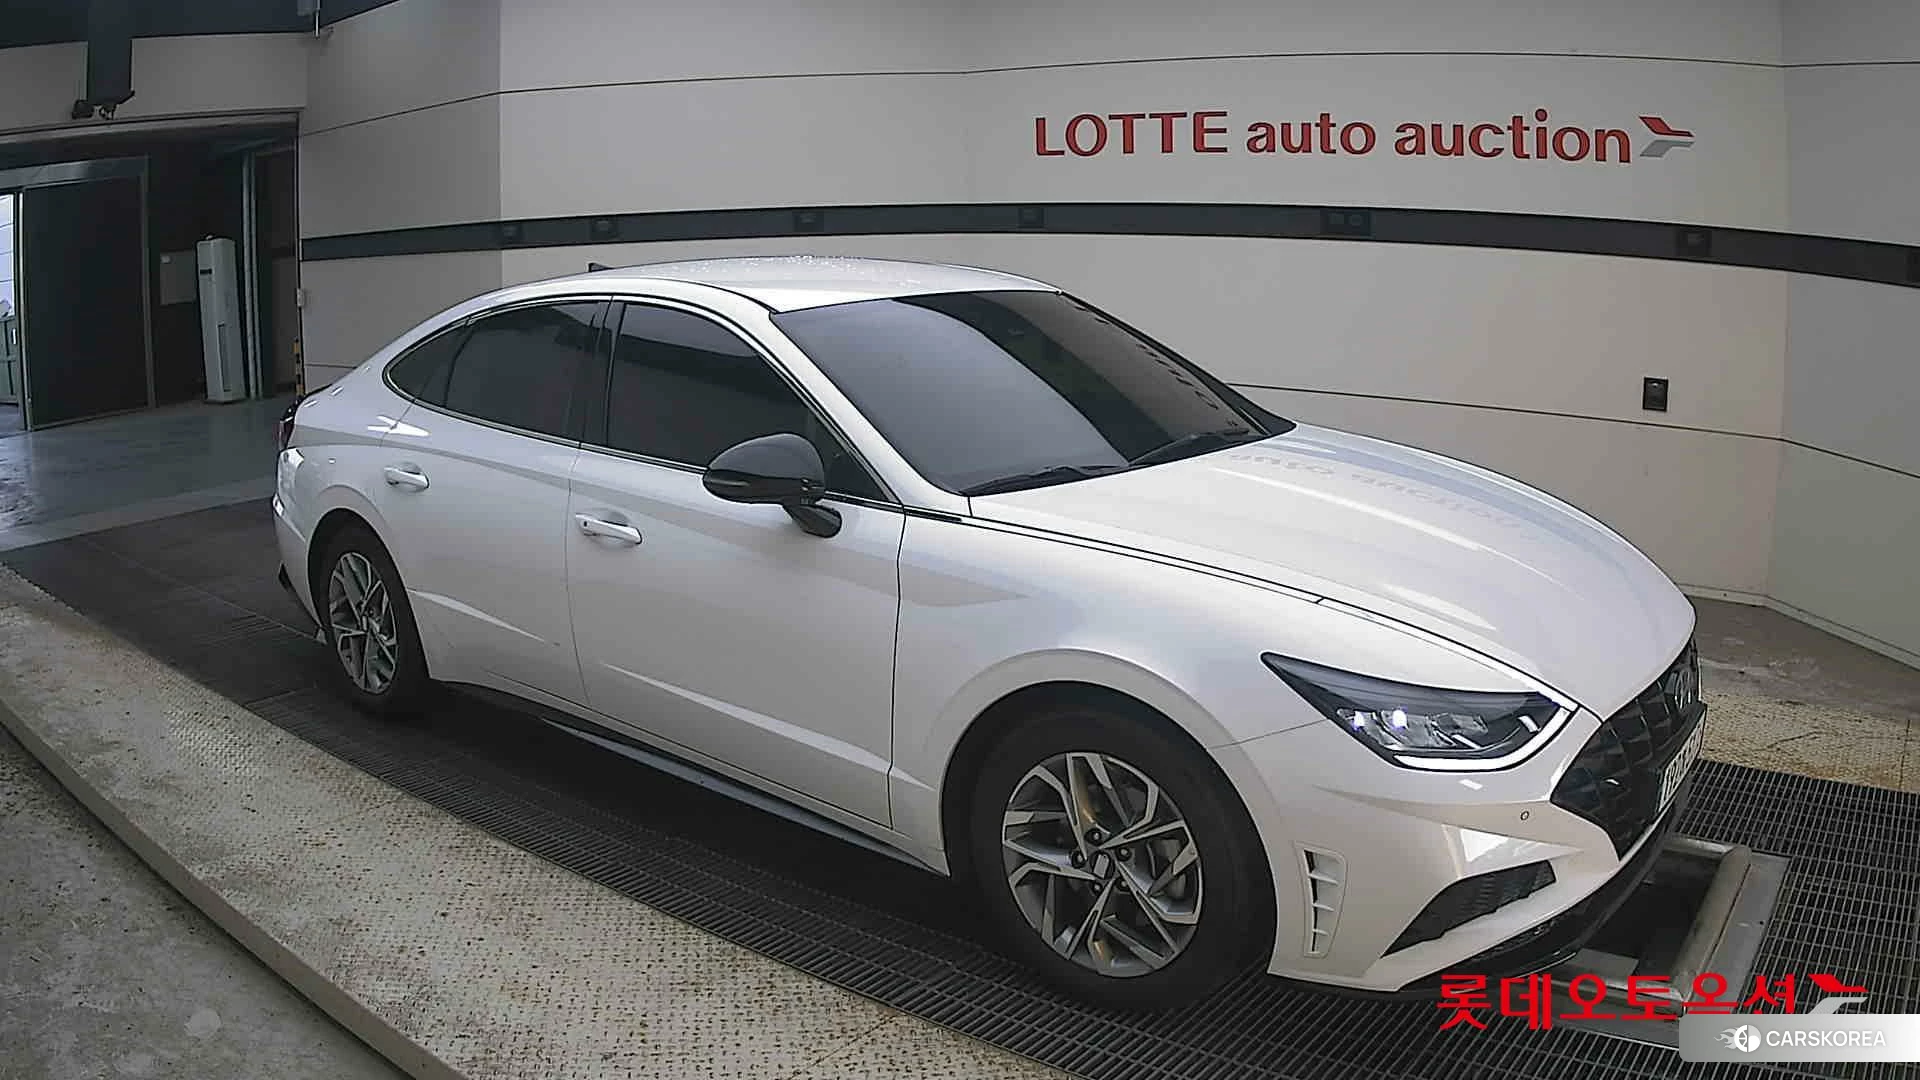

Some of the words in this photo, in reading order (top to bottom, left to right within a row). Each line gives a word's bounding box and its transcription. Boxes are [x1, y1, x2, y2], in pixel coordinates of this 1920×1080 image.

[1035, 111, 1229, 157] LOTTE
[1246, 112, 1377, 156] auto
[1394, 109, 1632, 164] auction
